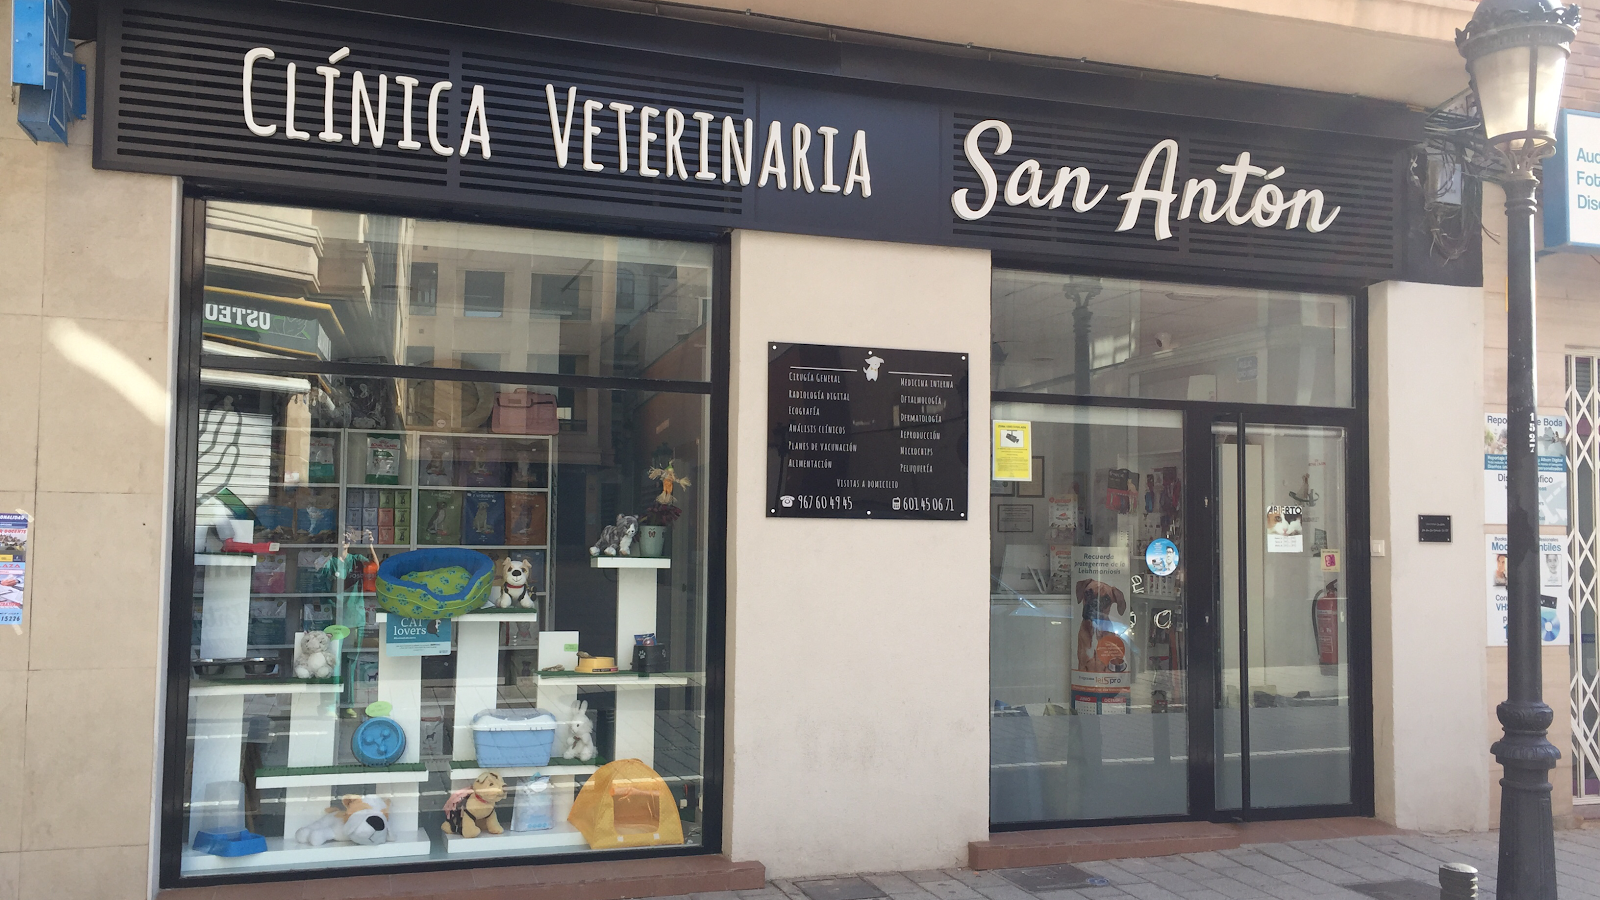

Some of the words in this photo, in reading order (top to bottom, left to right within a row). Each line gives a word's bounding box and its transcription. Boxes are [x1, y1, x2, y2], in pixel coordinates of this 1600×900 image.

[242, 47, 491, 160] CLÍNICA
[545, 83, 872, 199] VETERINARIA
[951, 119, 1109, 221] San
[1114, 138, 1341, 241] Antón
[1578, 194, 1600, 211] Dis
[816, 373, 840, 383] GENERAL
[900, 378, 928, 387] MEDICINA
[930, 380, 953, 388] INTERNA
[827, 392, 850, 401] DIGITAL
[788, 406, 820, 416] ECOGRAFÍA
[1487, 416, 1507, 426] Repo
[1543, 418, 1563, 427] Boda
[818, 424, 846, 434] CLÍNICOS
[788, 441, 809, 450] PLANES
[811, 443, 817, 451] DE
[820, 442, 857, 452] VACUNACIÓN
[900, 446, 933, 456] MICROCHIPS
[788, 458, 832, 468] ALIMENTACIÓN
[900, 463, 933, 474] PELUQUERÍA
[836, 479, 859, 488] VISITAS
[862, 480, 865, 488] A
[868, 480, 898, 489] DOMICILIO
[1267, 505, 1302, 515] ABIERTO
[1539, 543, 1562, 552] ntiles
[394, 626, 426, 636] lovers
